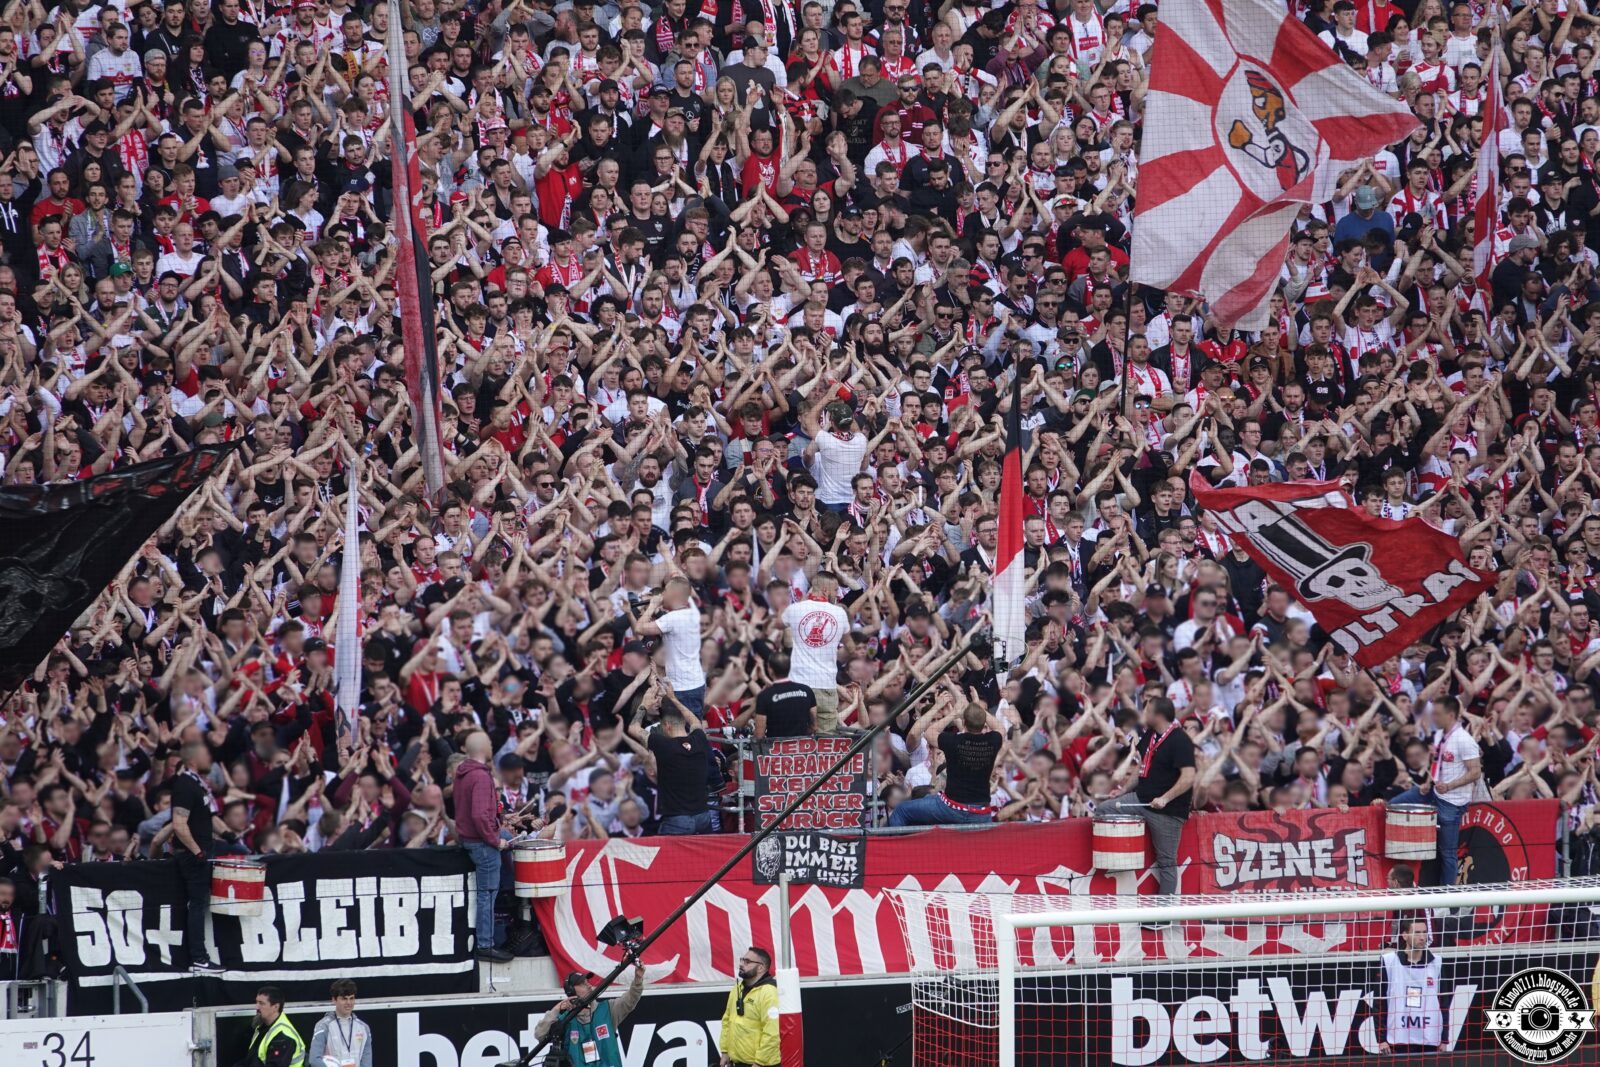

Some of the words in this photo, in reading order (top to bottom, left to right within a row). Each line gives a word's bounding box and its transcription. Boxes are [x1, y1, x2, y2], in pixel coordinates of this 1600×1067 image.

[772, 689, 808, 703] Commando
[769, 738, 853, 755] JEDER
[785, 835, 811, 850] DU
[819, 837, 860, 855] BIST
[785, 851, 858, 873] IMMER
[1213, 832, 1337, 888] SZENE
[1344, 828, 1370, 887] E
[1401, 1016, 1431, 1029] SMF
[42, 1031, 95, 1067] 34
